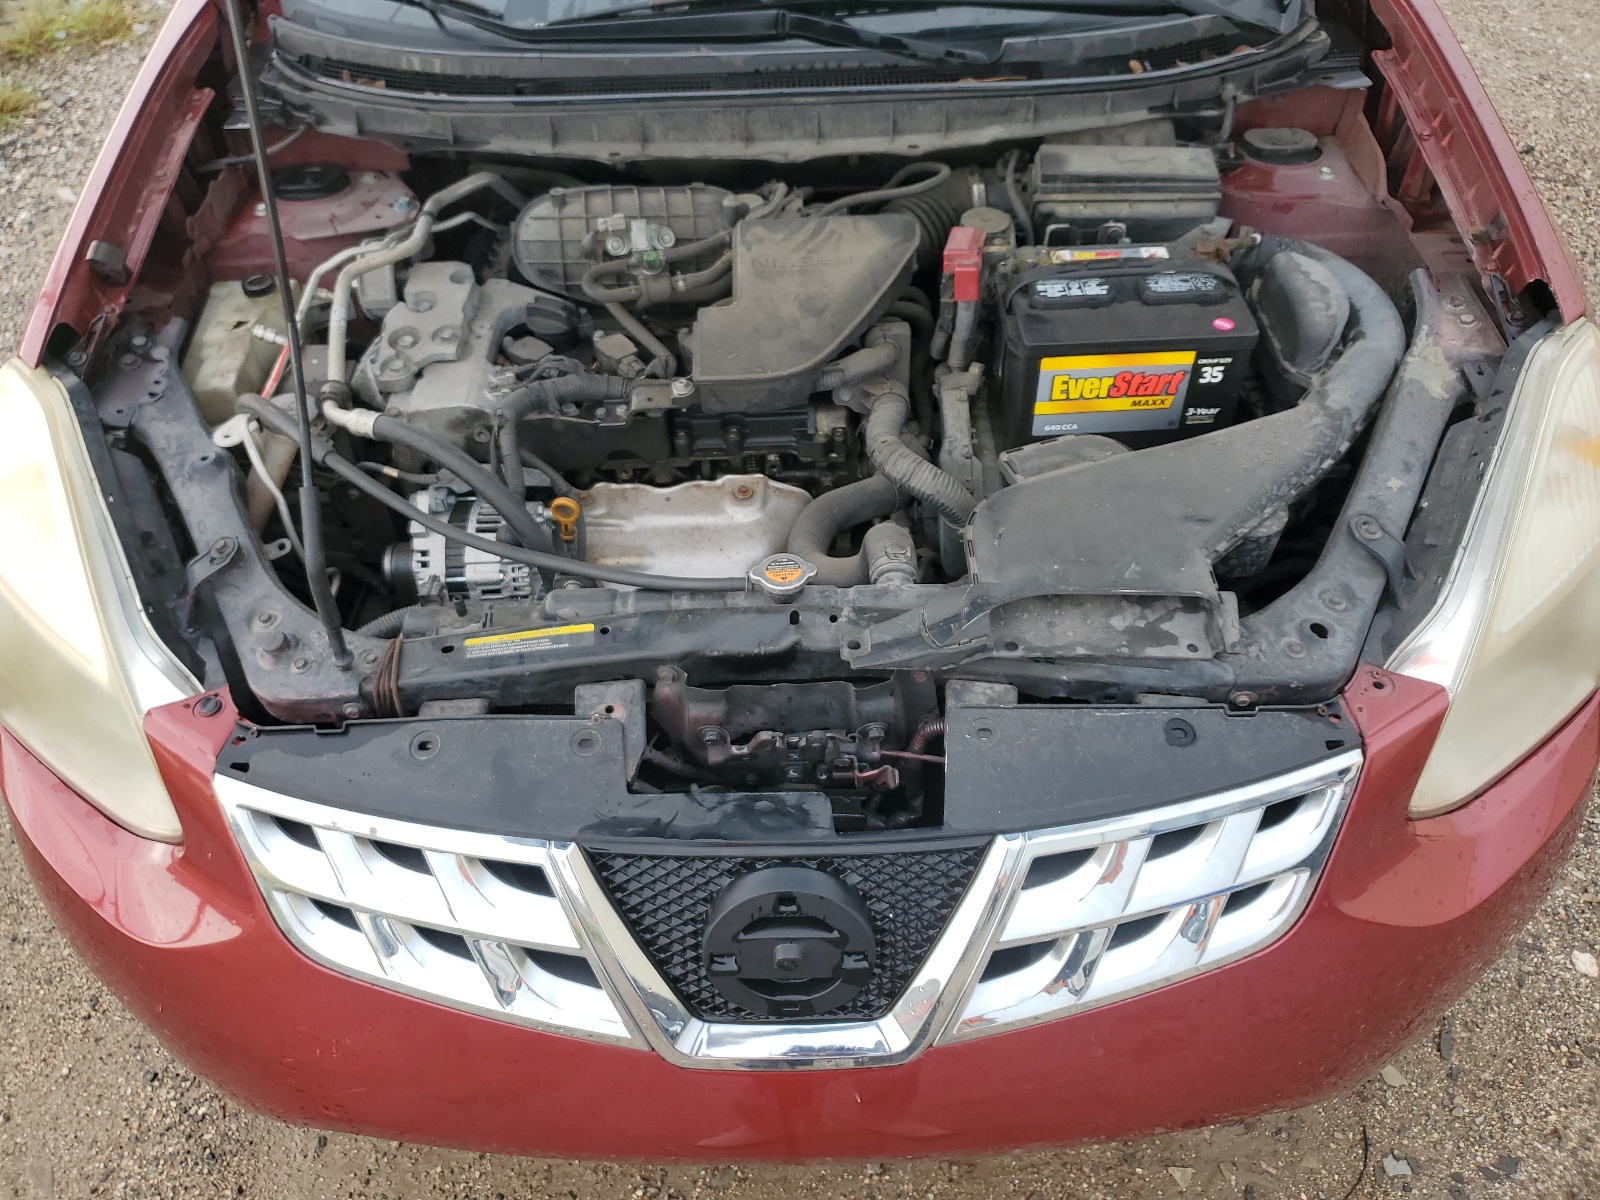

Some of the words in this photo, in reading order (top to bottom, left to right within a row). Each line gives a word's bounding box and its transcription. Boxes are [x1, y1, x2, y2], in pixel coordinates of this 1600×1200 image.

[1199, 366, 1226, 384] 35
[1051, 371, 1187, 401] EverStart
[1130, 398, 1168, 408] MAXX
[1185, 407, 1222, 417] 3-Year
[1061, 423, 1078, 431] CCA
